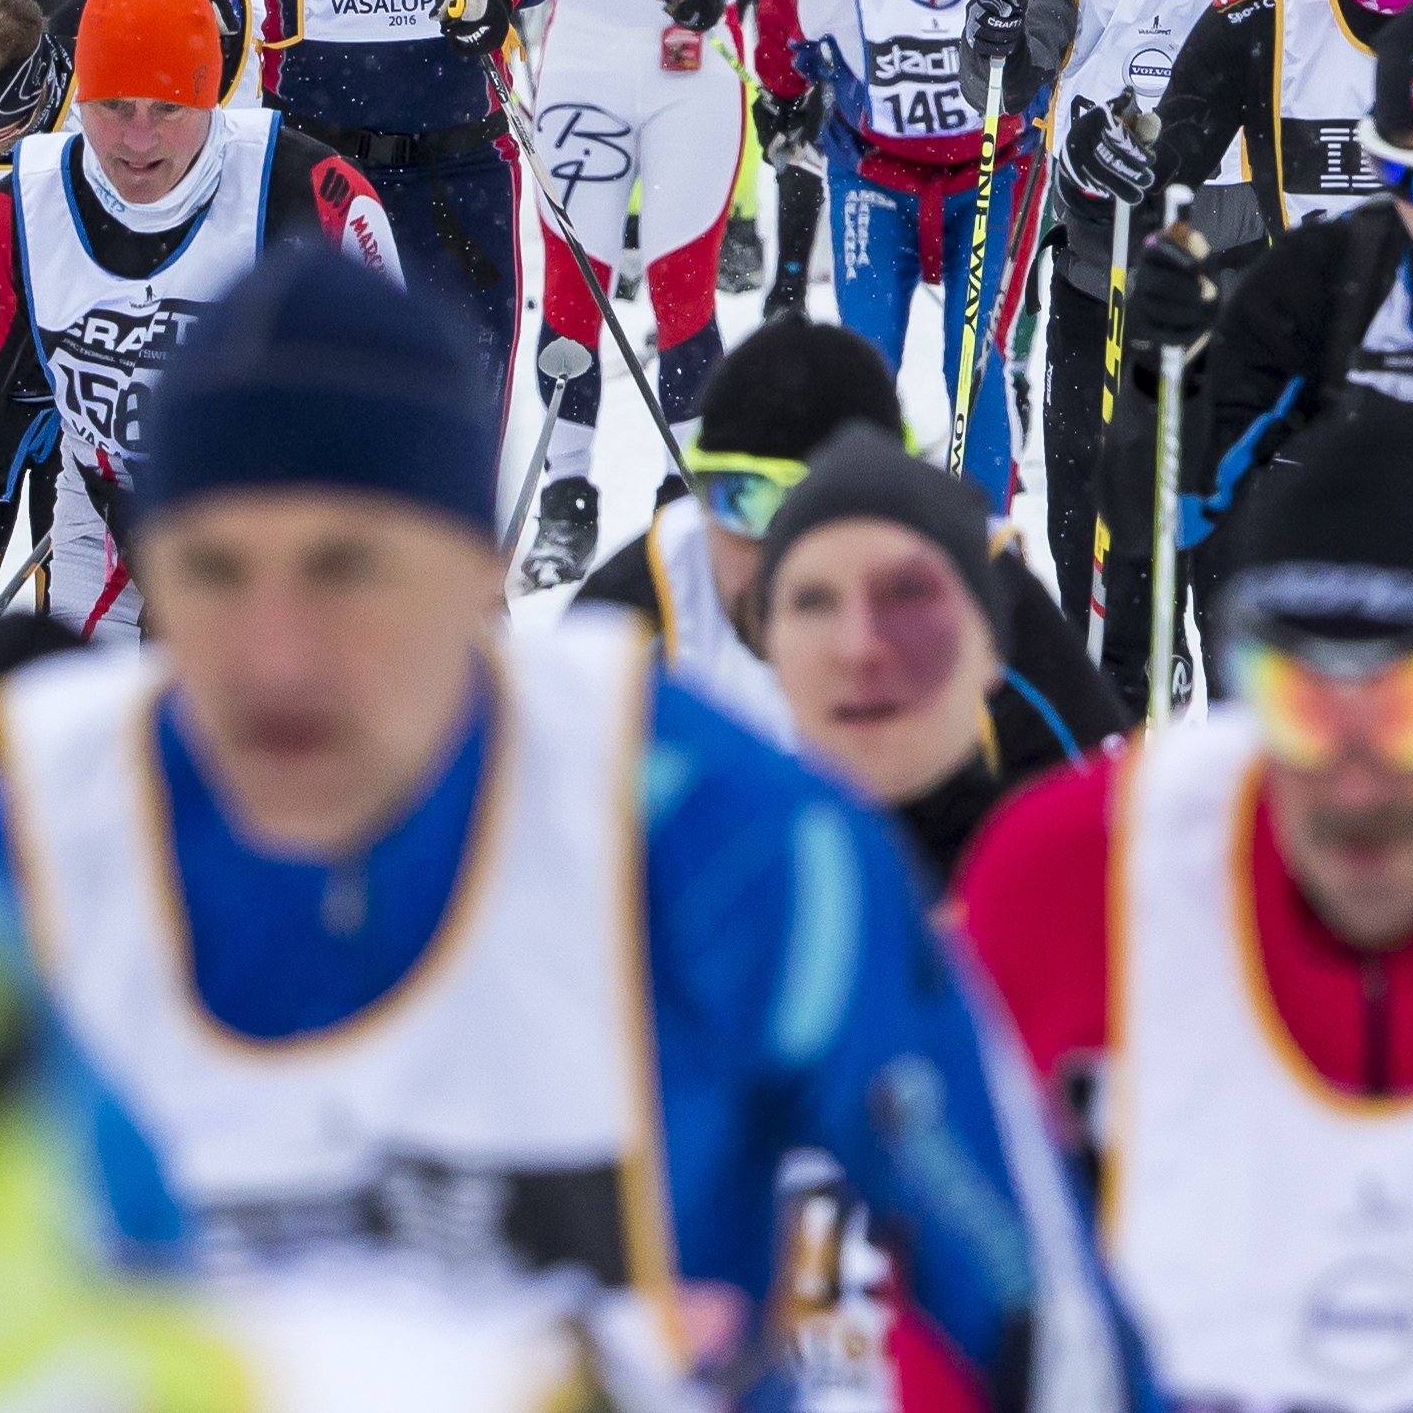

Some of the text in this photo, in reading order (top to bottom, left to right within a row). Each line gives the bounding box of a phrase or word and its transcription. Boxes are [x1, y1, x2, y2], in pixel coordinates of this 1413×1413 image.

[389, 14, 417, 27] 2016
[876, 44, 960, 80] stadi
[1132, 66, 1172, 76] VOLVO
